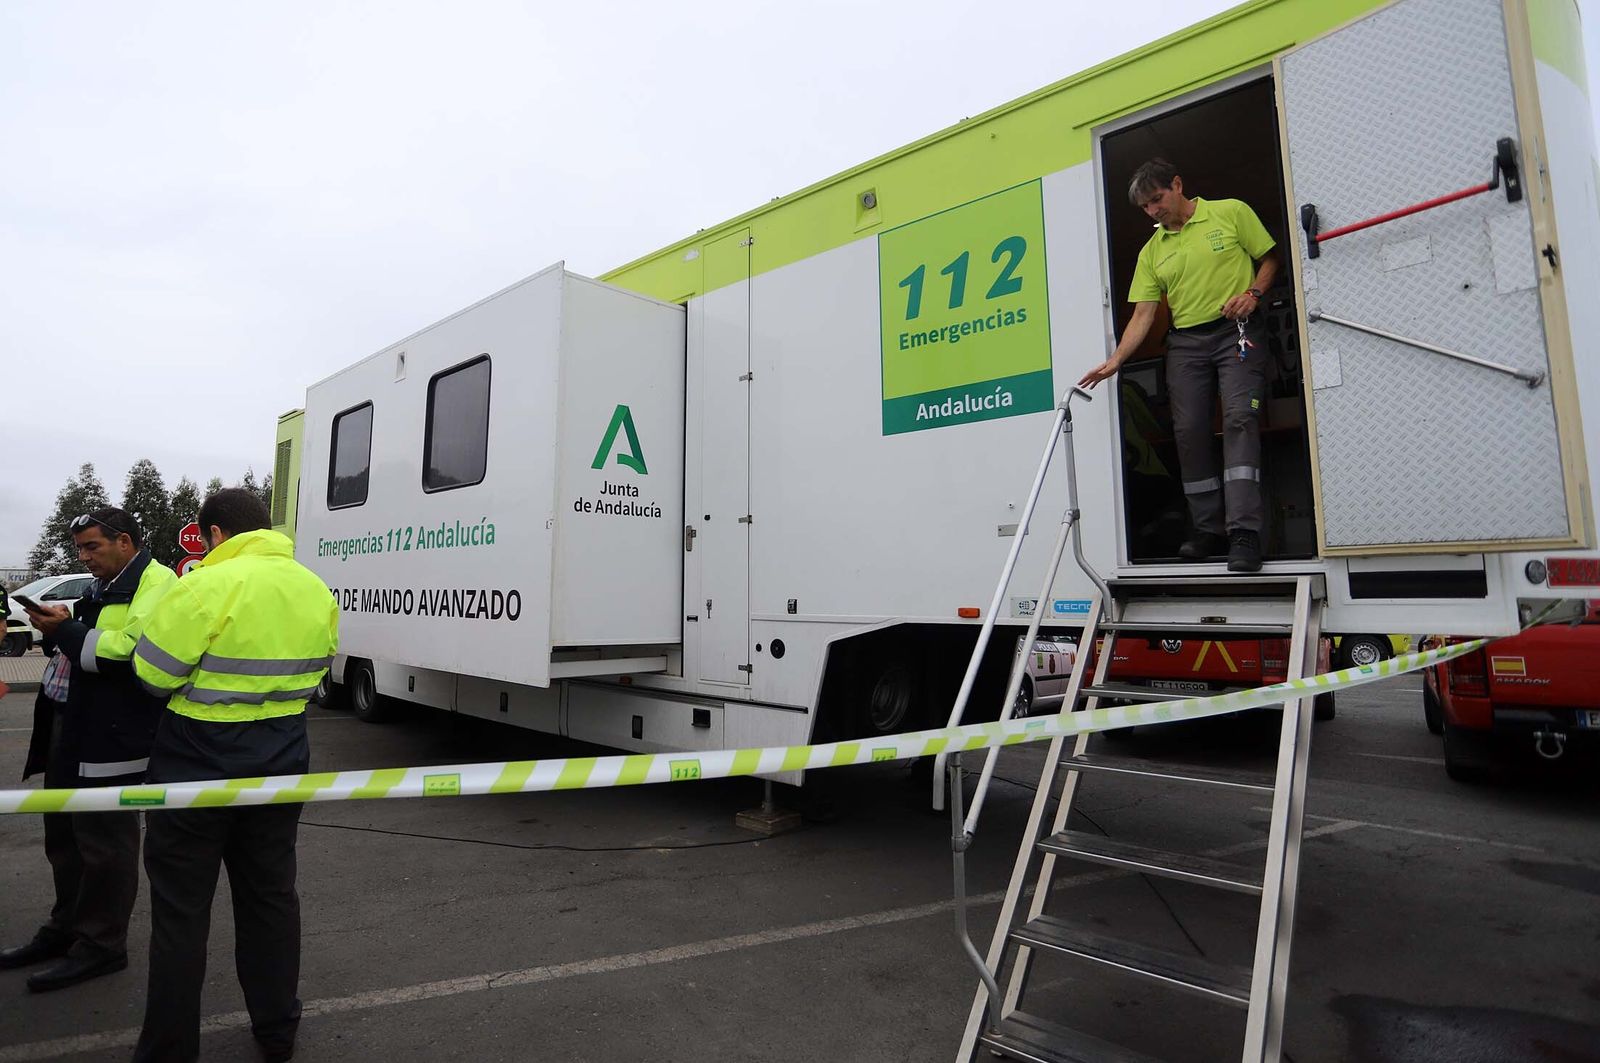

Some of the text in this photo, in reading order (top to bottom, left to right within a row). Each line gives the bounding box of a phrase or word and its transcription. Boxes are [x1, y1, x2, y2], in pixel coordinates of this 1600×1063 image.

[898, 235, 1028, 321] 112
[899, 306, 1028, 351] Emergencias
[915, 386, 1013, 421] Andalucía
[600, 480, 639, 498] Junta
[573, 497, 662, 518] de Andalucía
[183, 534, 202, 542] STO
[317, 517, 496, 562] Emergencias 112 Andalucía
[342, 588, 358, 612] DE
[360, 588, 414, 616] MANDO
[417, 589, 522, 622] AVANZADO
[674, 767, 698, 778] 112
